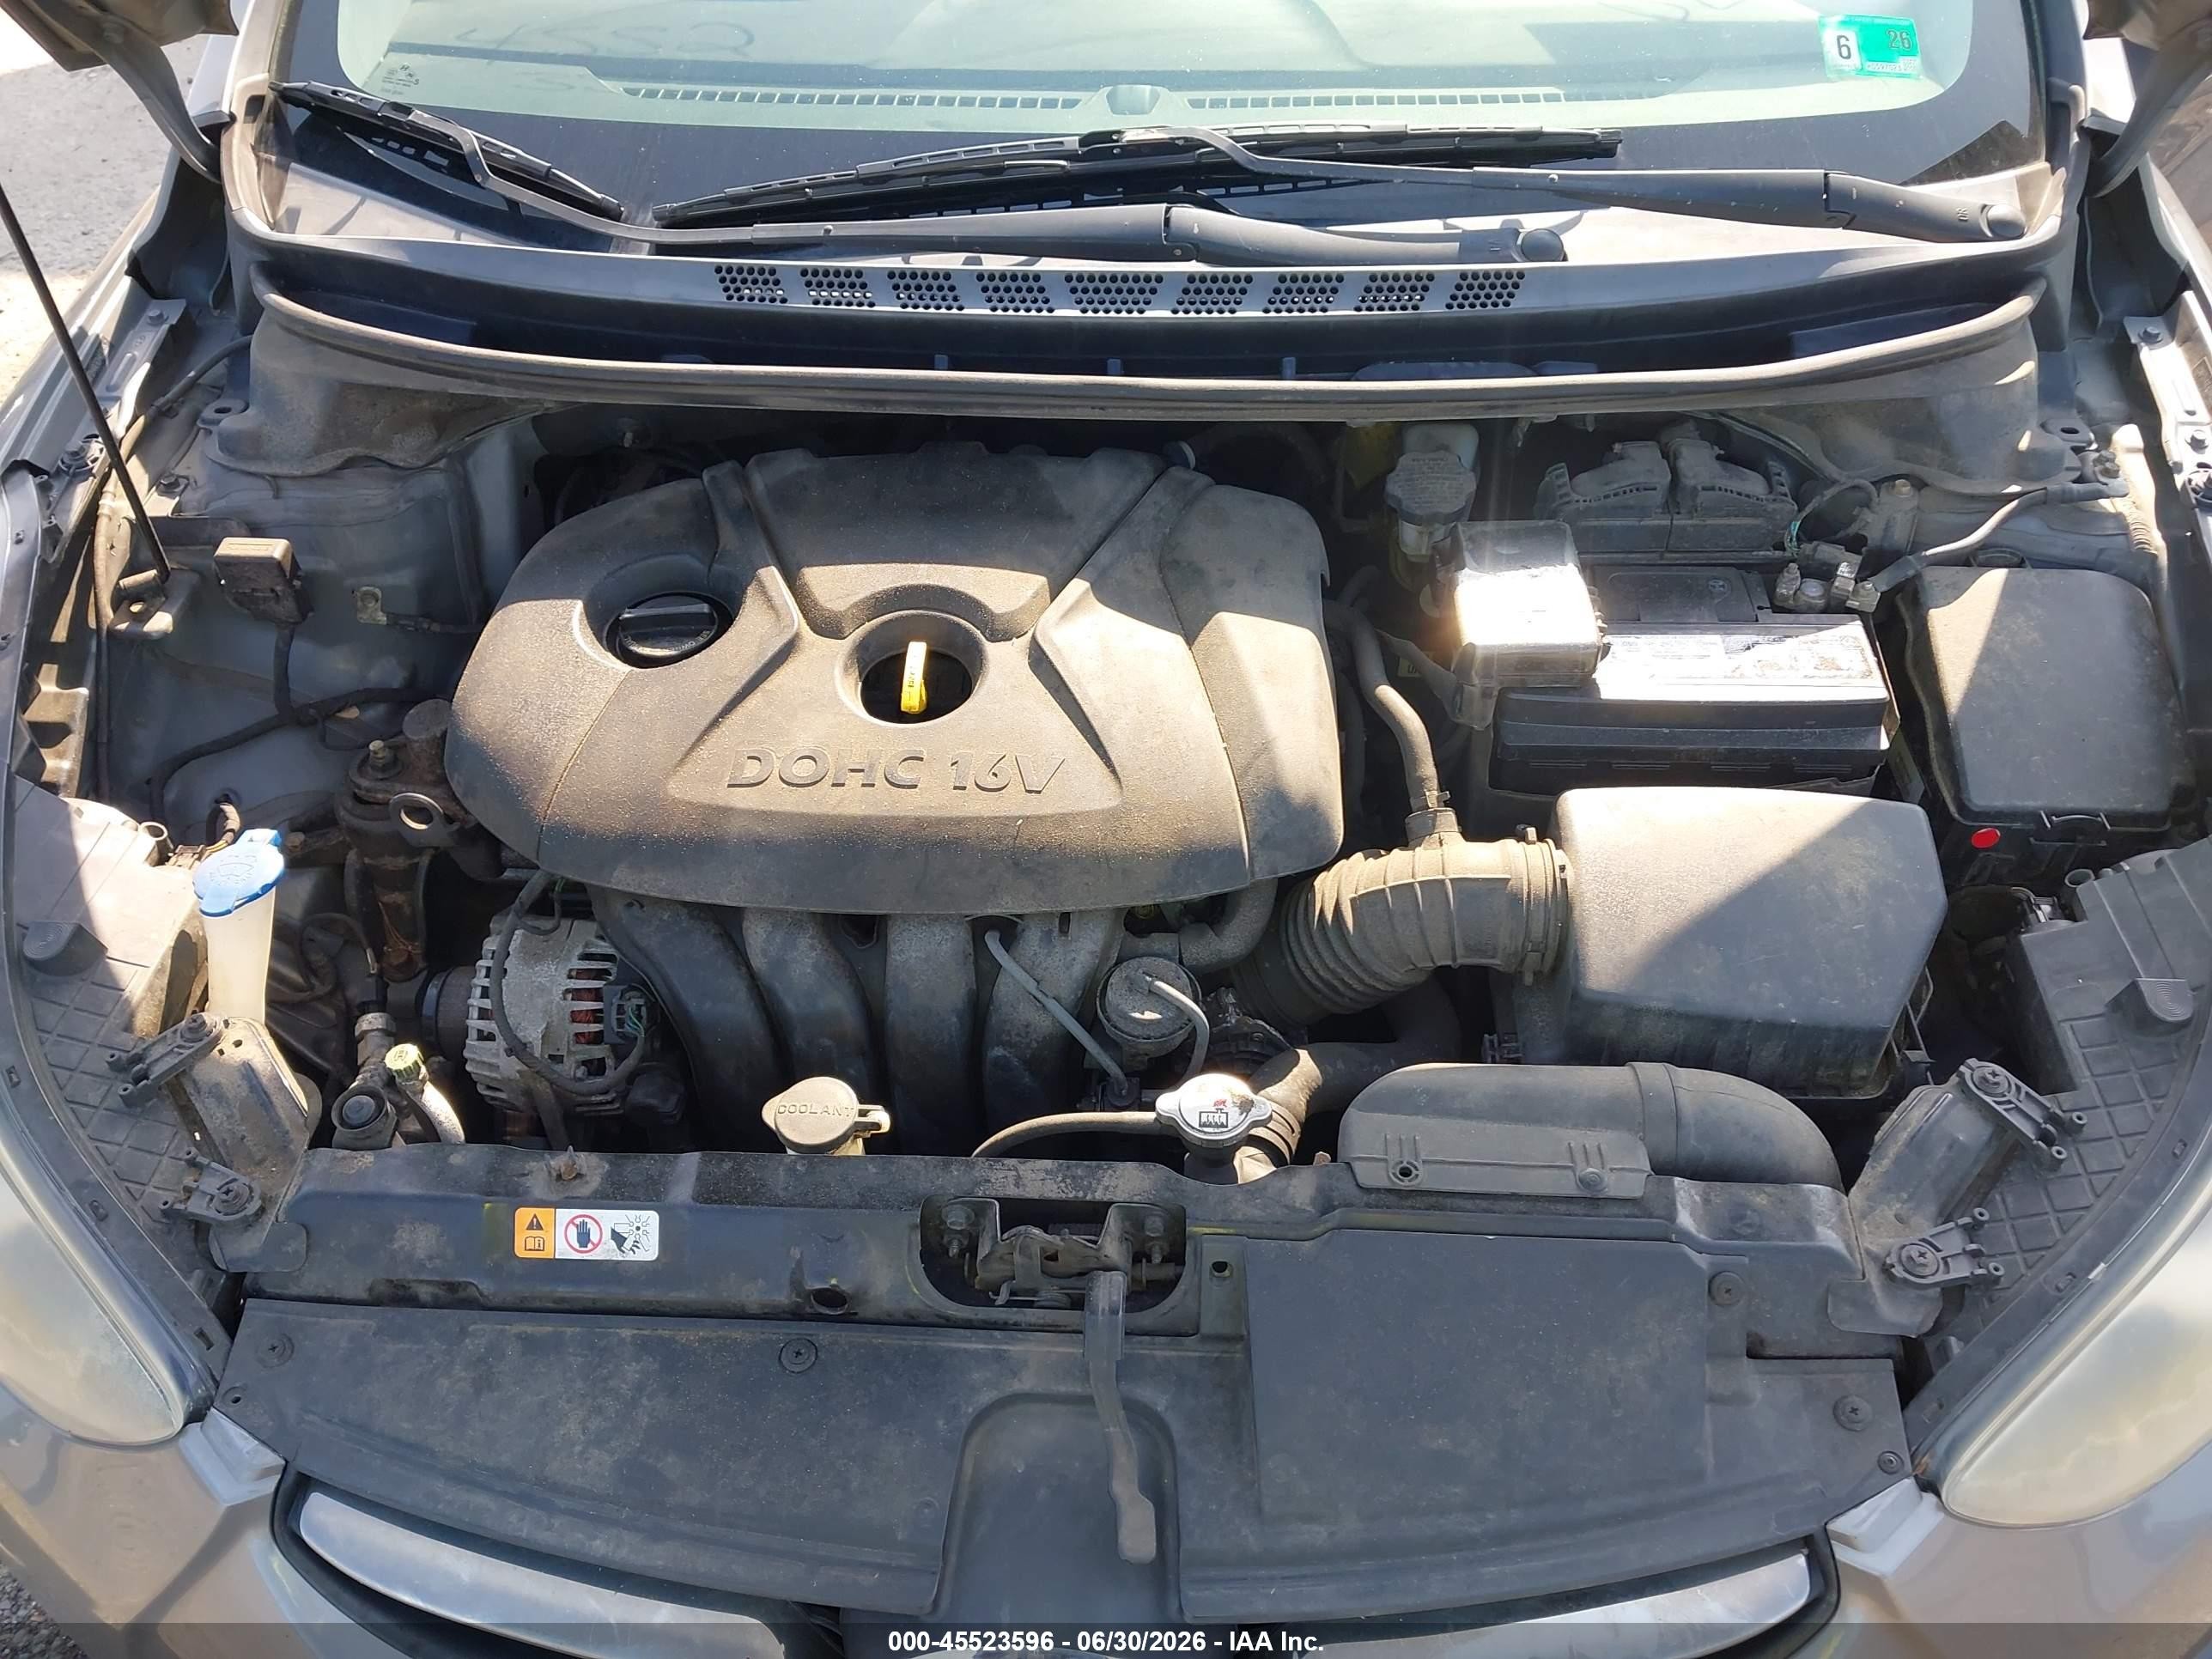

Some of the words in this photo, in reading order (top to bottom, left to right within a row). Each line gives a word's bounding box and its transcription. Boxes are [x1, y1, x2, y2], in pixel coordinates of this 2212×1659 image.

[1836, 34, 1852, 60] 6
[1887, 29, 1913, 51] 26
[726, 747, 926, 789] DOHC
[949, 752, 1066, 794] 16V
[776, 1102, 855, 1119] COOLANT
